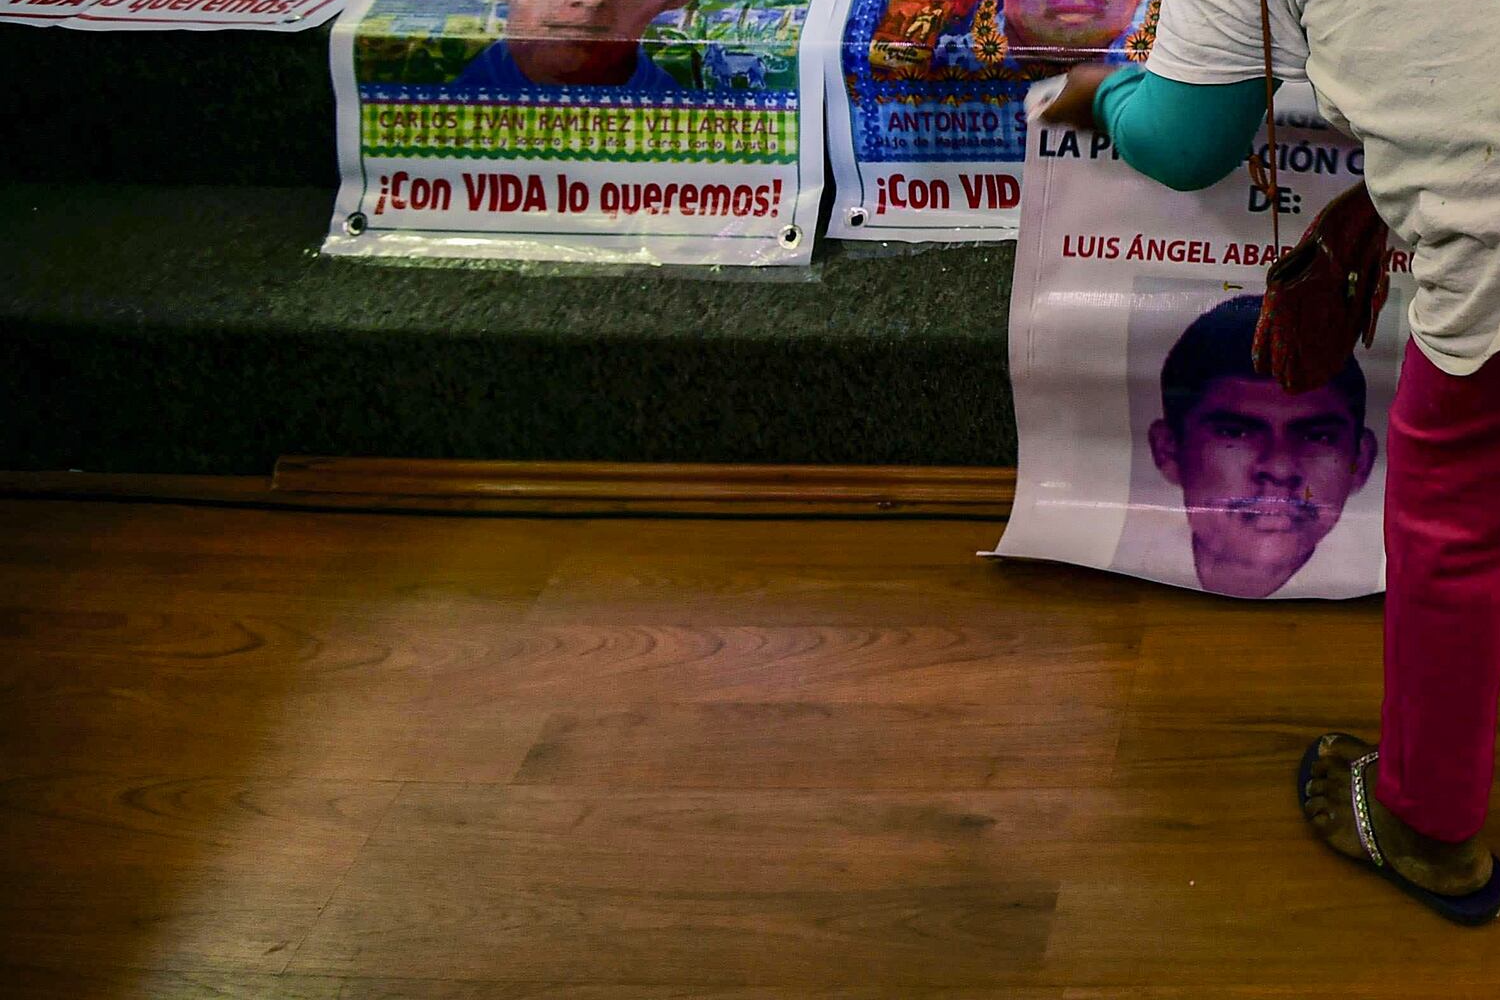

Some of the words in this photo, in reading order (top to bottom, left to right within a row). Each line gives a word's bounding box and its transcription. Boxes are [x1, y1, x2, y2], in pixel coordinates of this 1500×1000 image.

[378, 111, 458, 129] CARLOS
[473, 109, 524, 130] IVÁN
[539, 111, 631, 133] RAMÍREZ
[646, 116, 779, 135] VILLARREAL
[888, 110, 999, 131] ANTONIO
[1039, 130, 1080, 158] LA
[375, 172, 451, 214] ¡Con
[465, 174, 547, 213] VIDA
[558, 175, 589, 214] lo
[600, 179, 782, 217] queremos!
[877, 175, 949, 216] ¡Con
[1247, 183, 1302, 214] DE:
[1062, 234, 1120, 259] LUIS
[1127, 233, 1212, 264] ÁNGEL
